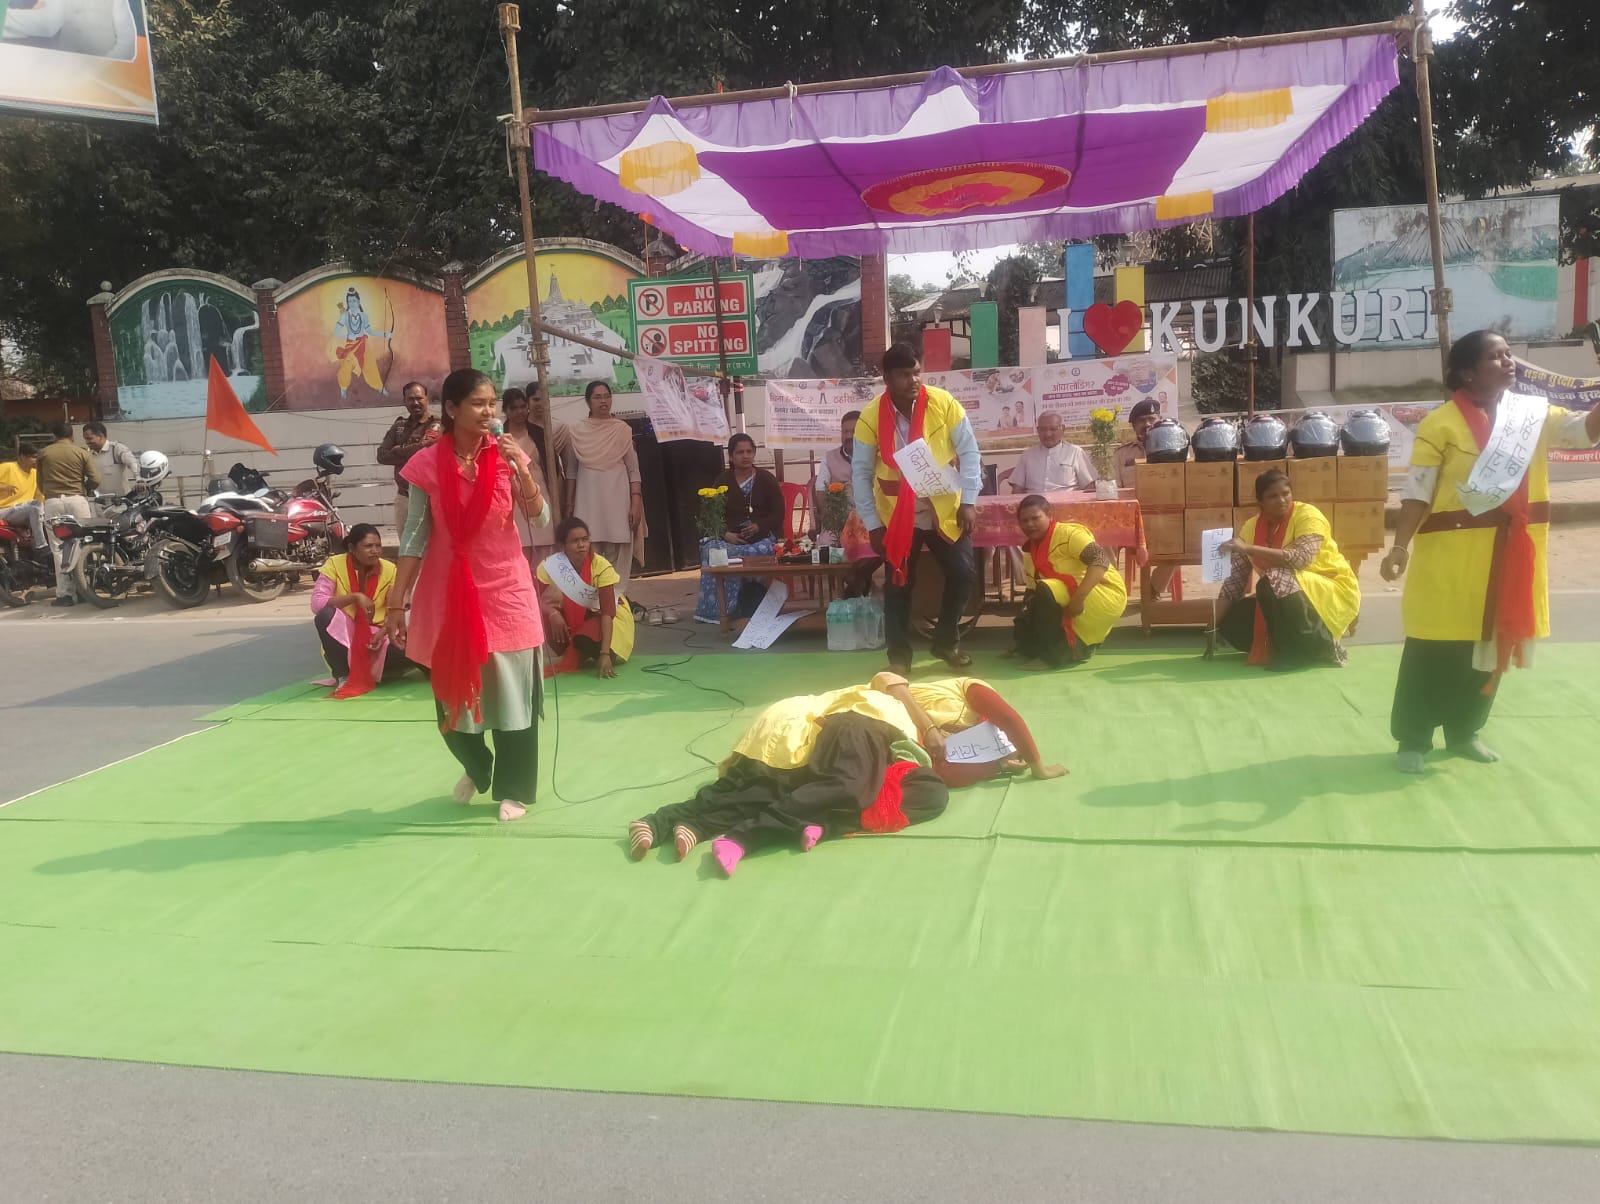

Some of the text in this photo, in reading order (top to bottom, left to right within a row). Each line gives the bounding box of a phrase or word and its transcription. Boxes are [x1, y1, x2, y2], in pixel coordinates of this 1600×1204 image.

[695, 286, 715, 299] NO
[1057, 286, 1439, 359] I KUNKURI
[698, 325, 718, 339] NO
[674, 337, 744, 354] SPITTNG
